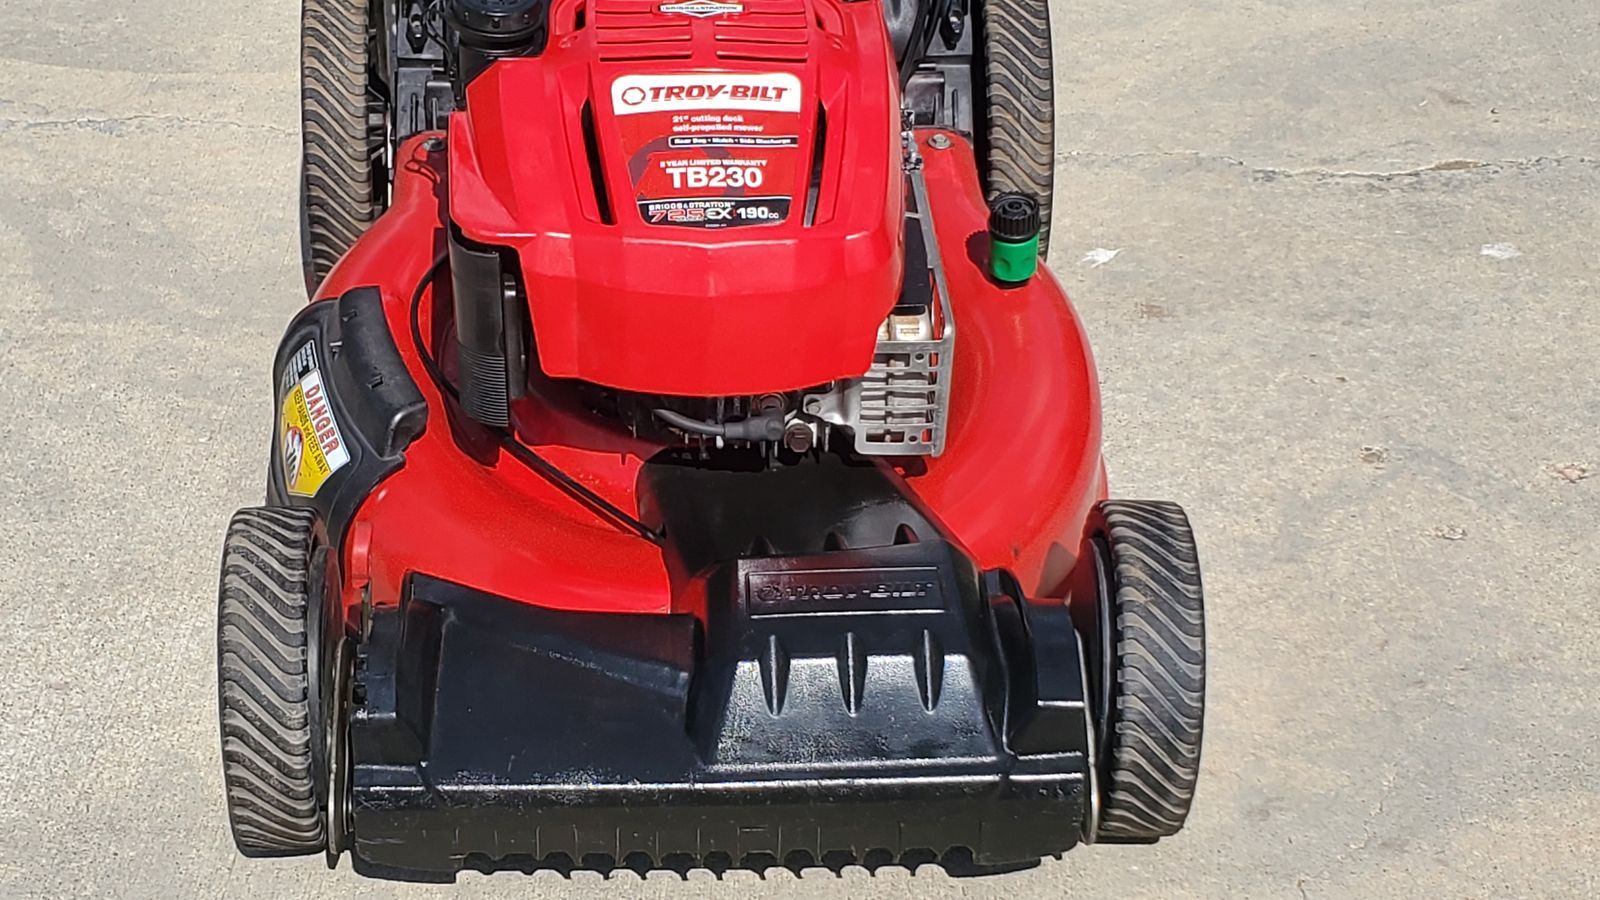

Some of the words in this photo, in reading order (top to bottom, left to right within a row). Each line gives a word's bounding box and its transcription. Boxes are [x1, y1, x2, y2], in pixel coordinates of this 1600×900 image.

[649, 84, 788, 102] TROY-BILT
[672, 124, 732, 133] self-propelled
[691, 115, 722, 124] cutting
[722, 115, 744, 123] deck
[721, 159, 768, 167] WARRANTY
[666, 167, 763, 189] TB230
[305, 384, 340, 456] DANGER
[308, 435, 319, 455] FEET
[314, 453, 328, 475] AWAY
